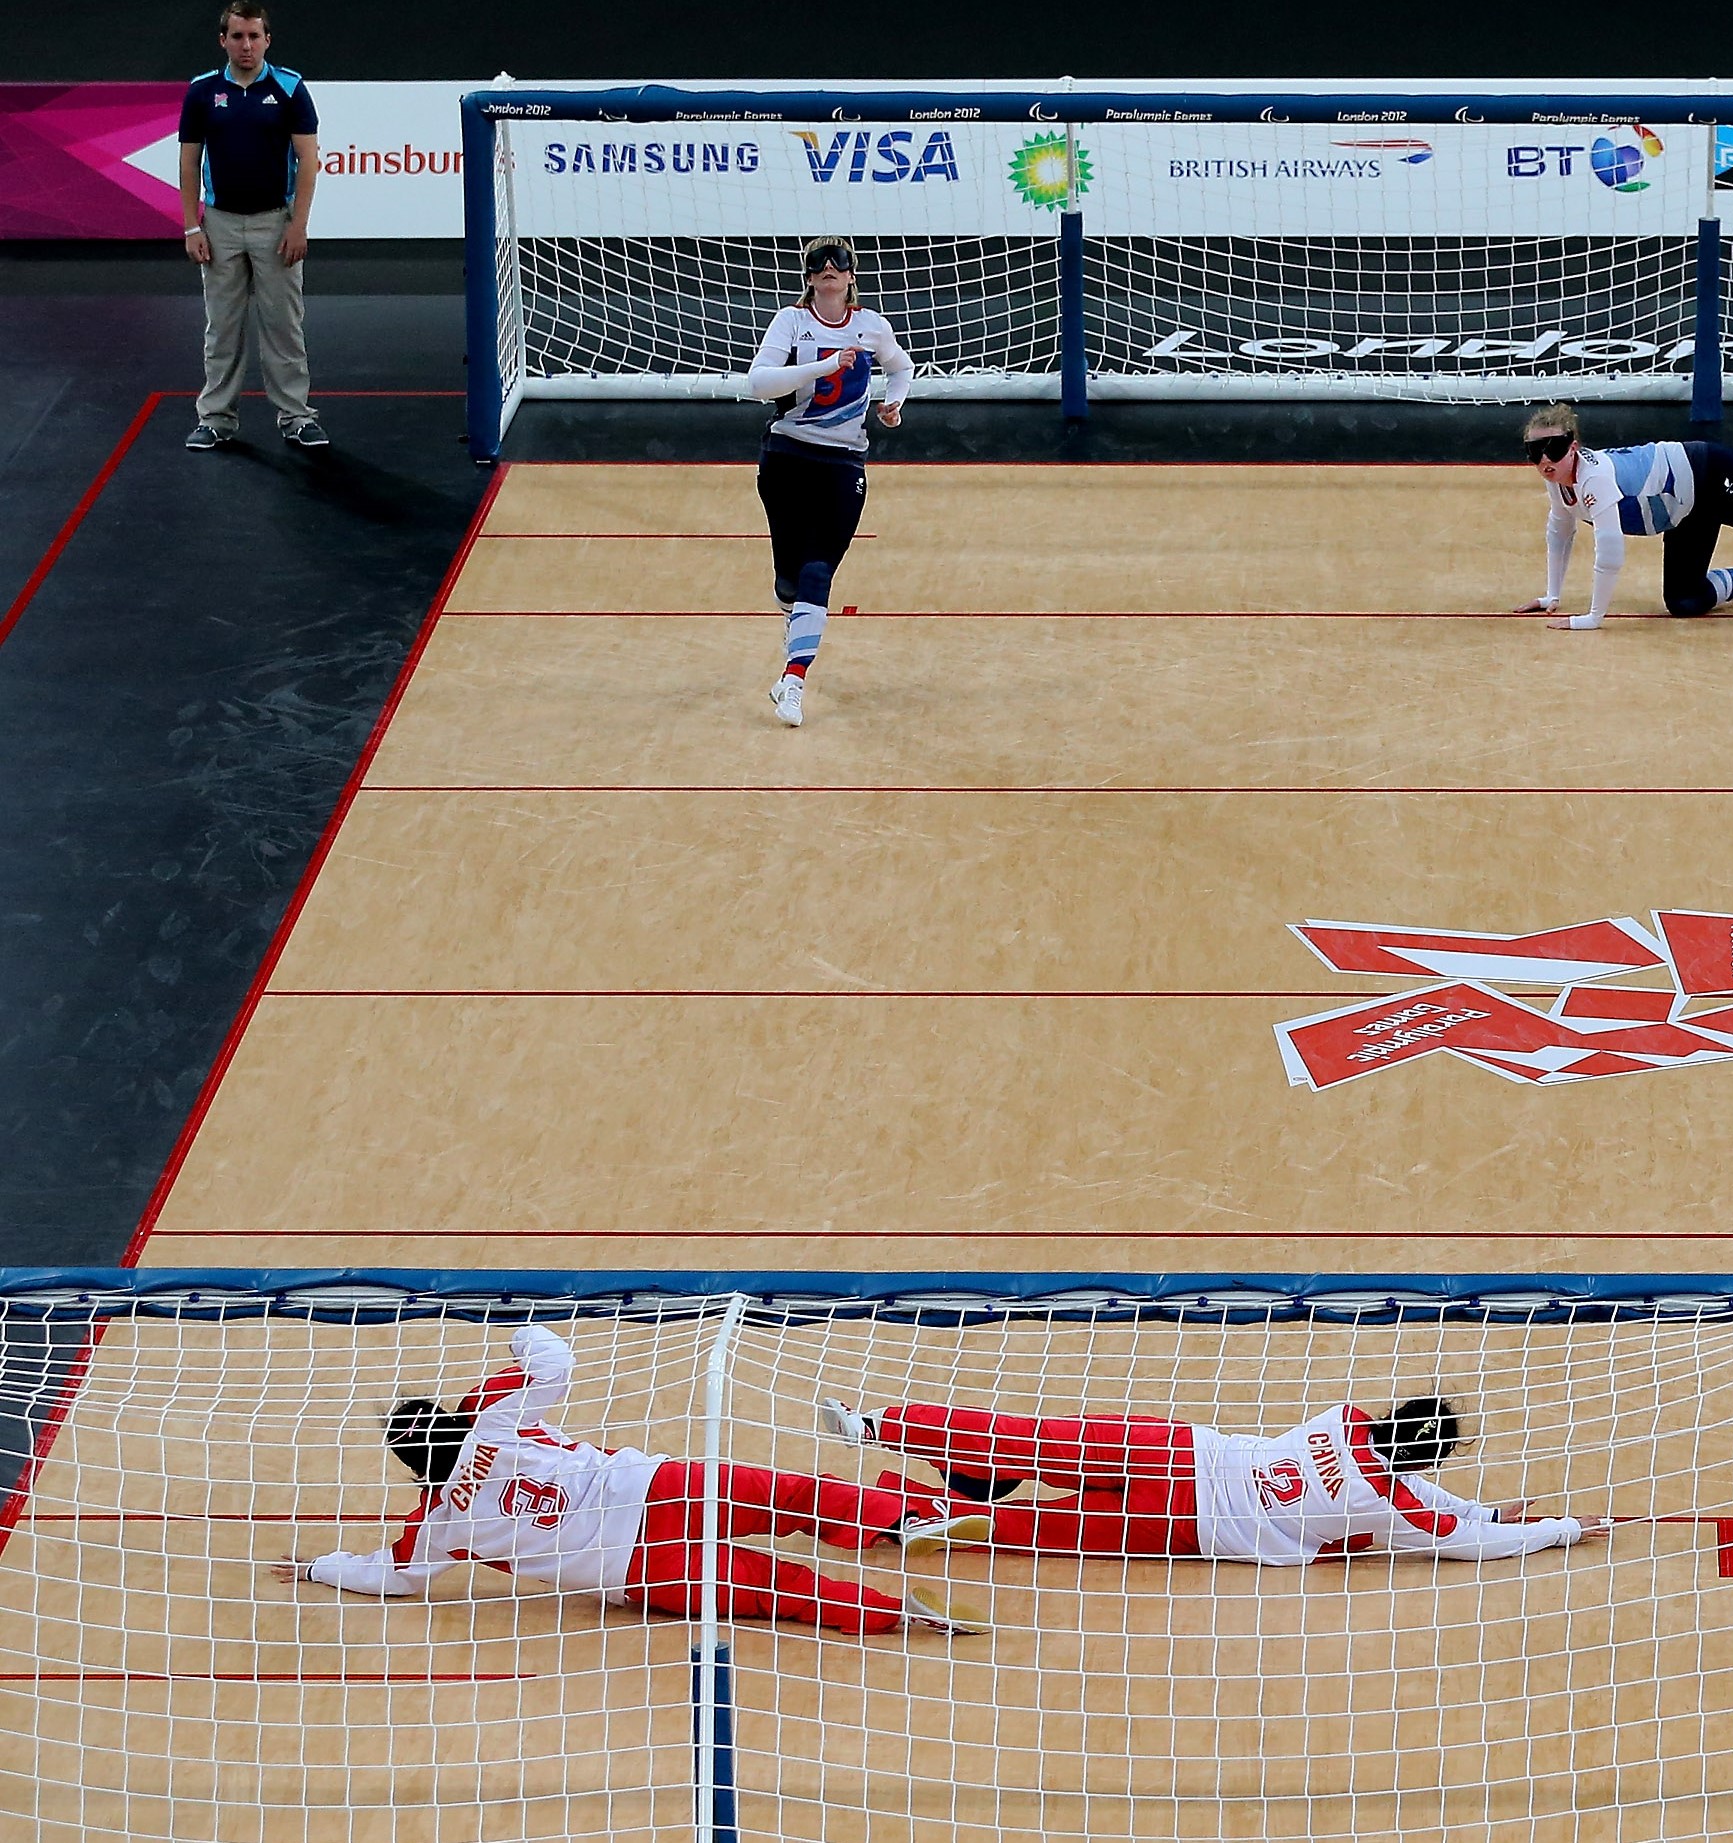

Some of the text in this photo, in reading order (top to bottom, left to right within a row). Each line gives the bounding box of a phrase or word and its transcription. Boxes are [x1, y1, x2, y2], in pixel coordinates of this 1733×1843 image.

[525, 104, 551, 116] 2012
[744, 112, 783, 120] Games
[909, 108, 981, 119] London 2012
[1105, 109, 1212, 122] Paralympic Games
[1337, 111, 1407, 121] London 2012
[1531, 112, 1640, 123] Paralympic Games
[544, 142, 761, 174] SAMSUNG
[789, 131, 960, 183] VISA
[1169, 159, 1381, 178] BRITISH AIRWAYS
[1507, 146, 1585, 177] BT
[1346, 1007, 1492, 1062] Paralympic
[1353, 1002, 1449, 1036] Games
[450, 1443, 500, 1513] CHINA
[1307, 1431, 1347, 1501] CHINA
[1253, 1458, 1309, 1512] 2
[498, 1472, 569, 1531] 3
